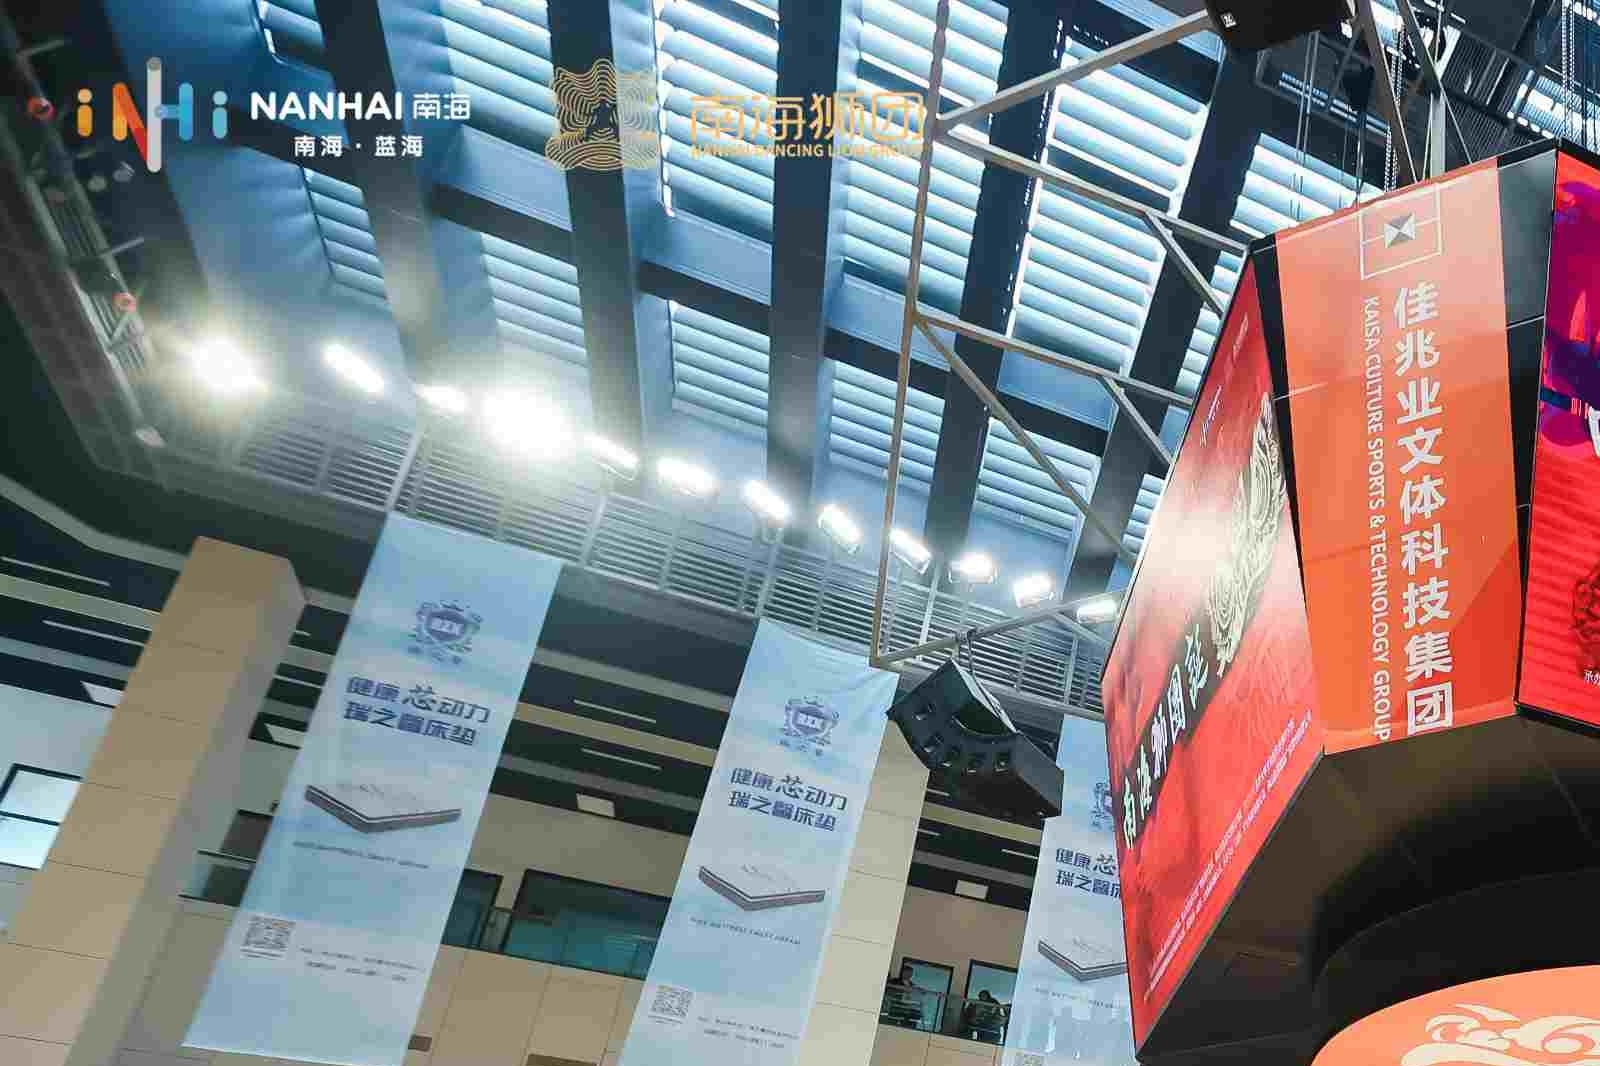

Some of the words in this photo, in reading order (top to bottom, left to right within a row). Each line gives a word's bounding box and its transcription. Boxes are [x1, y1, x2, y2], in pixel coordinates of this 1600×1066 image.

[1363, 296, 1381, 352] KAISA
[1364, 353, 1384, 434] CULTURE
[1367, 437, 1386, 510] SPORTS
[1393, 281, 1454, 737] 佳兆业文体科技集团
[1369, 514, 1387, 529] &
[1369, 529, 1391, 665] TECHNOLOGY
[1372, 671, 1394, 742] GROUP
[729, 767, 849, 812] 健康芯动力
